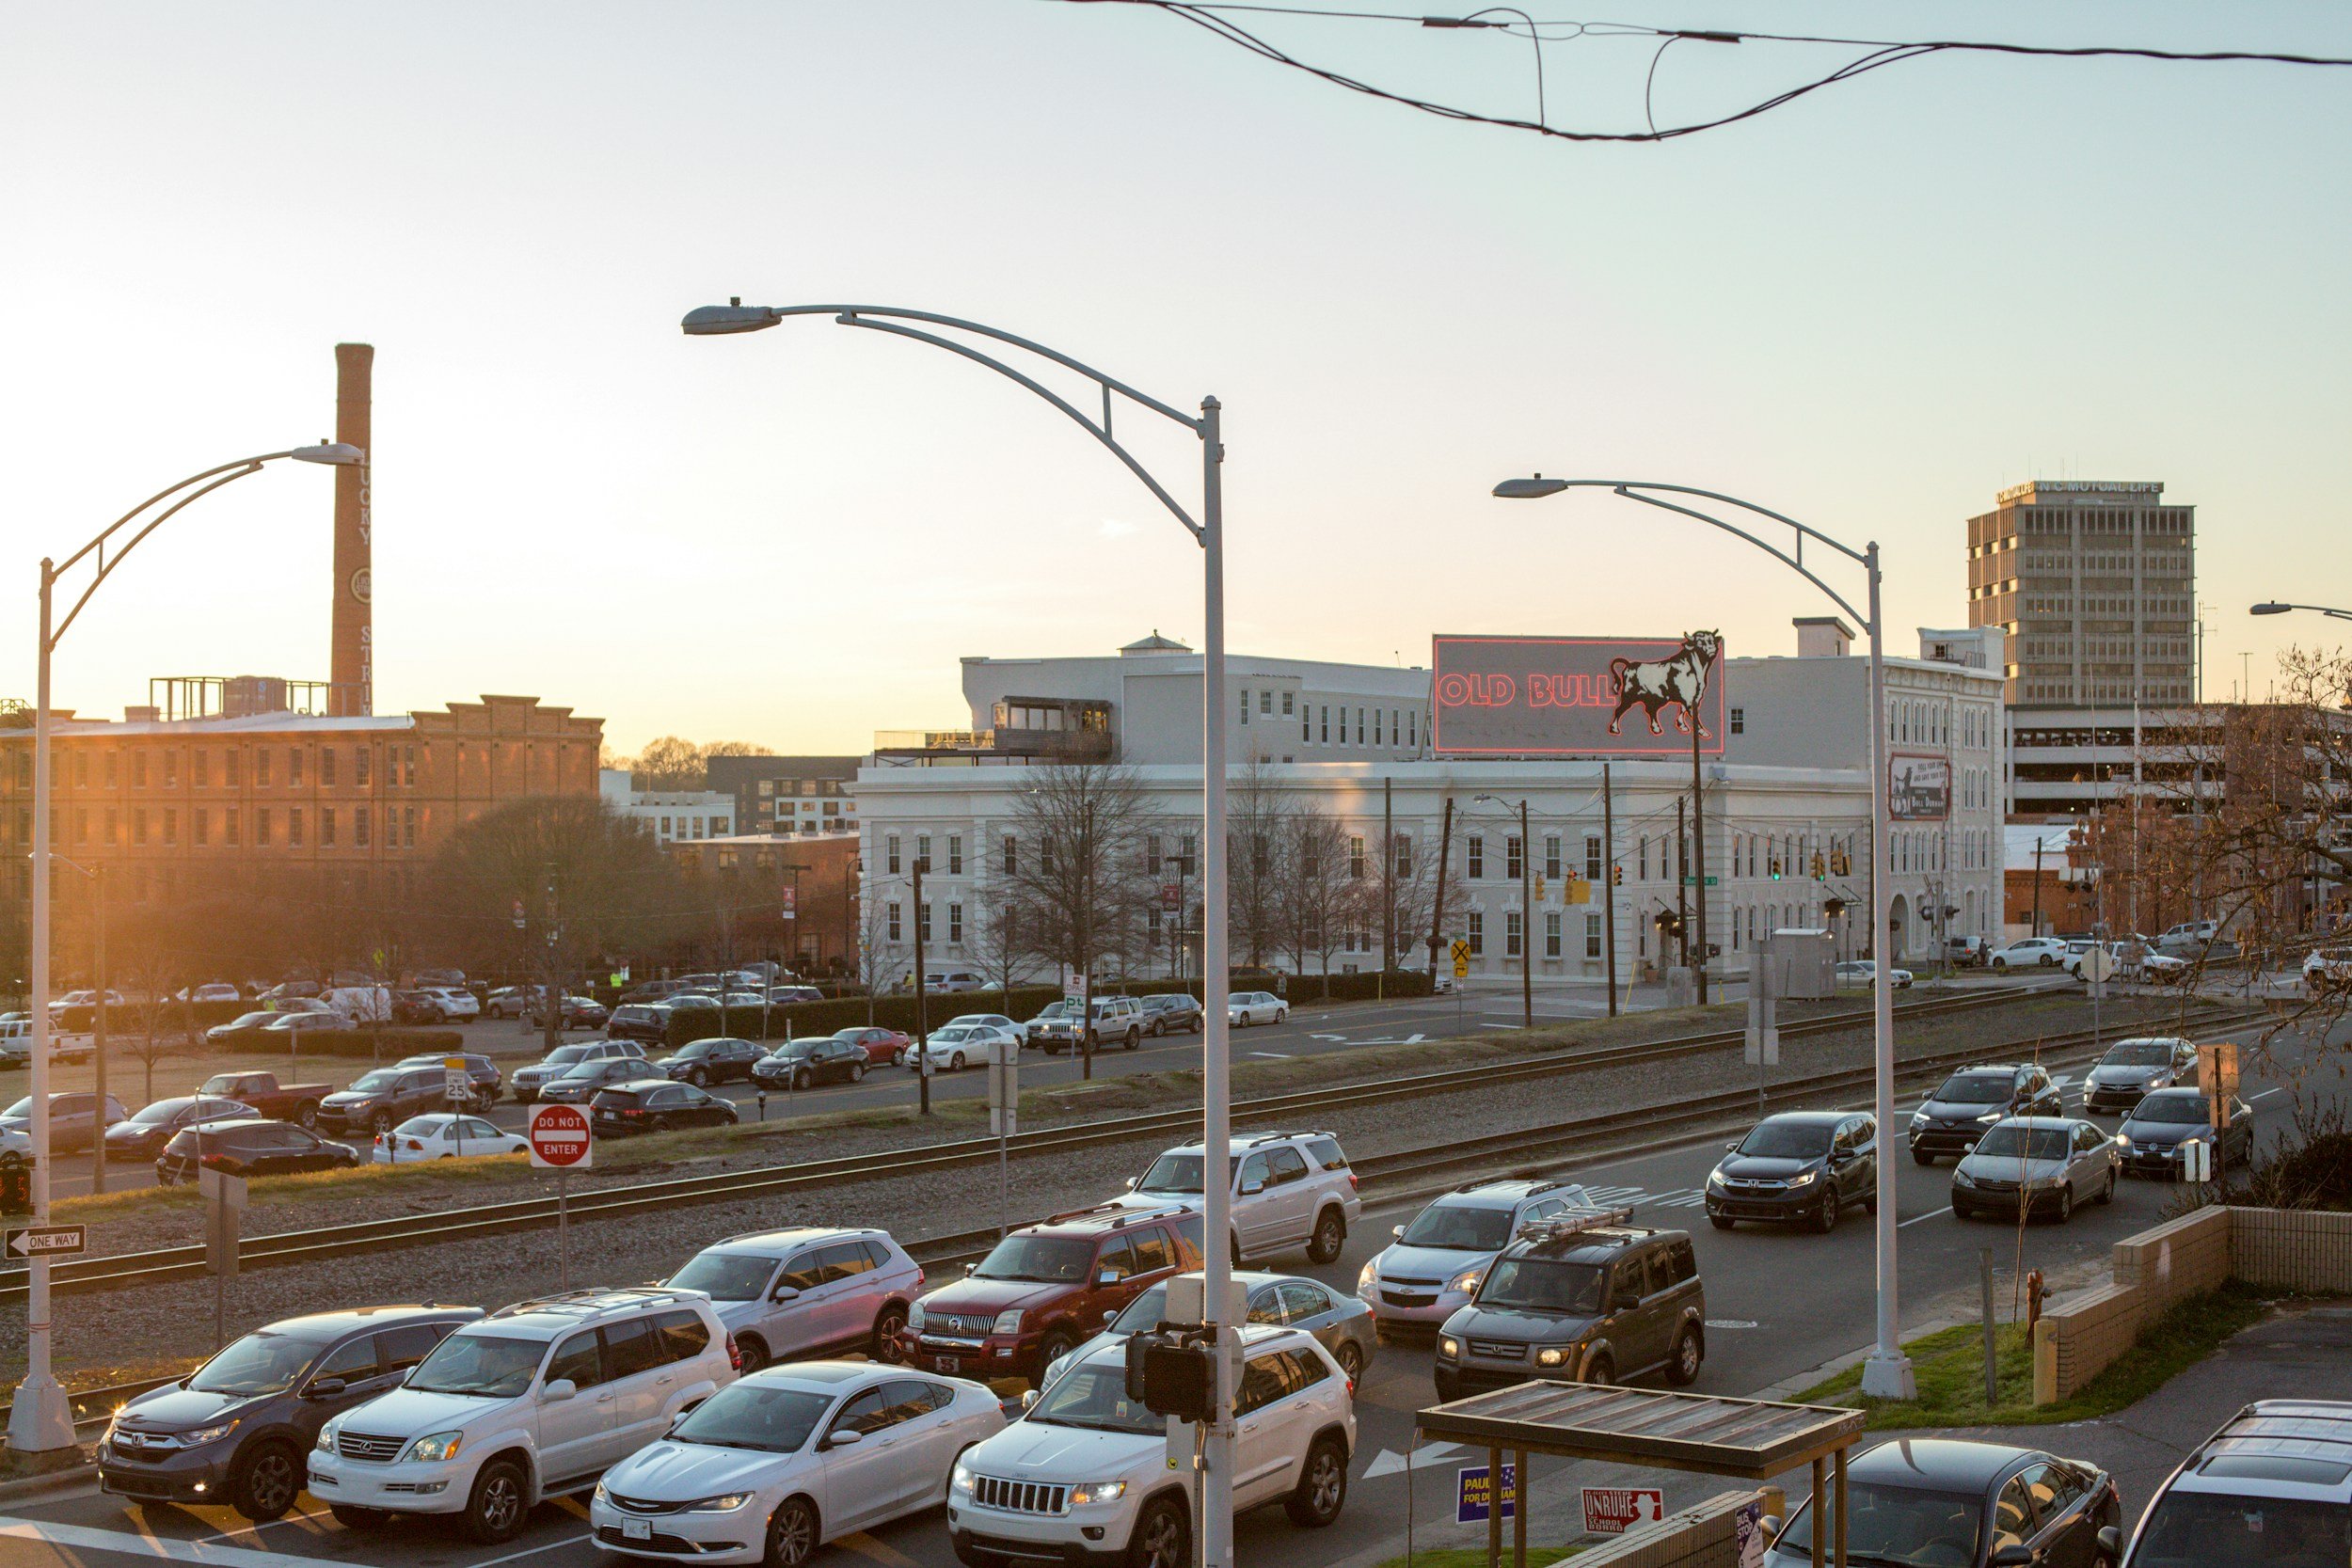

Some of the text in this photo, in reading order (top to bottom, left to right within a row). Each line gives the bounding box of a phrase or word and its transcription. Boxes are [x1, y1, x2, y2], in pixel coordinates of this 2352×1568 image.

[2040, 483, 2159, 493] N C MUTUAL LIFE
[1438, 673, 1616, 707] OLD BULL
[1066, 997, 1075, 1010] P
[448, 1085, 465, 1097] 25
[539, 1117, 581, 1128] DO NOT
[544, 1144, 579, 1155] ENTER
[30, 1233, 77, 1248] ONE WAY
[1464, 1477, 1489, 1491] PAUL
[1463, 1493, 1480, 1503] FOR
[1585, 1495, 1634, 1517] UNRUHE
[1736, 1511, 1750, 1528] BUS
[1589, 1524, 1623, 1532] BOARD
[1738, 1521, 1754, 1540] STOP
